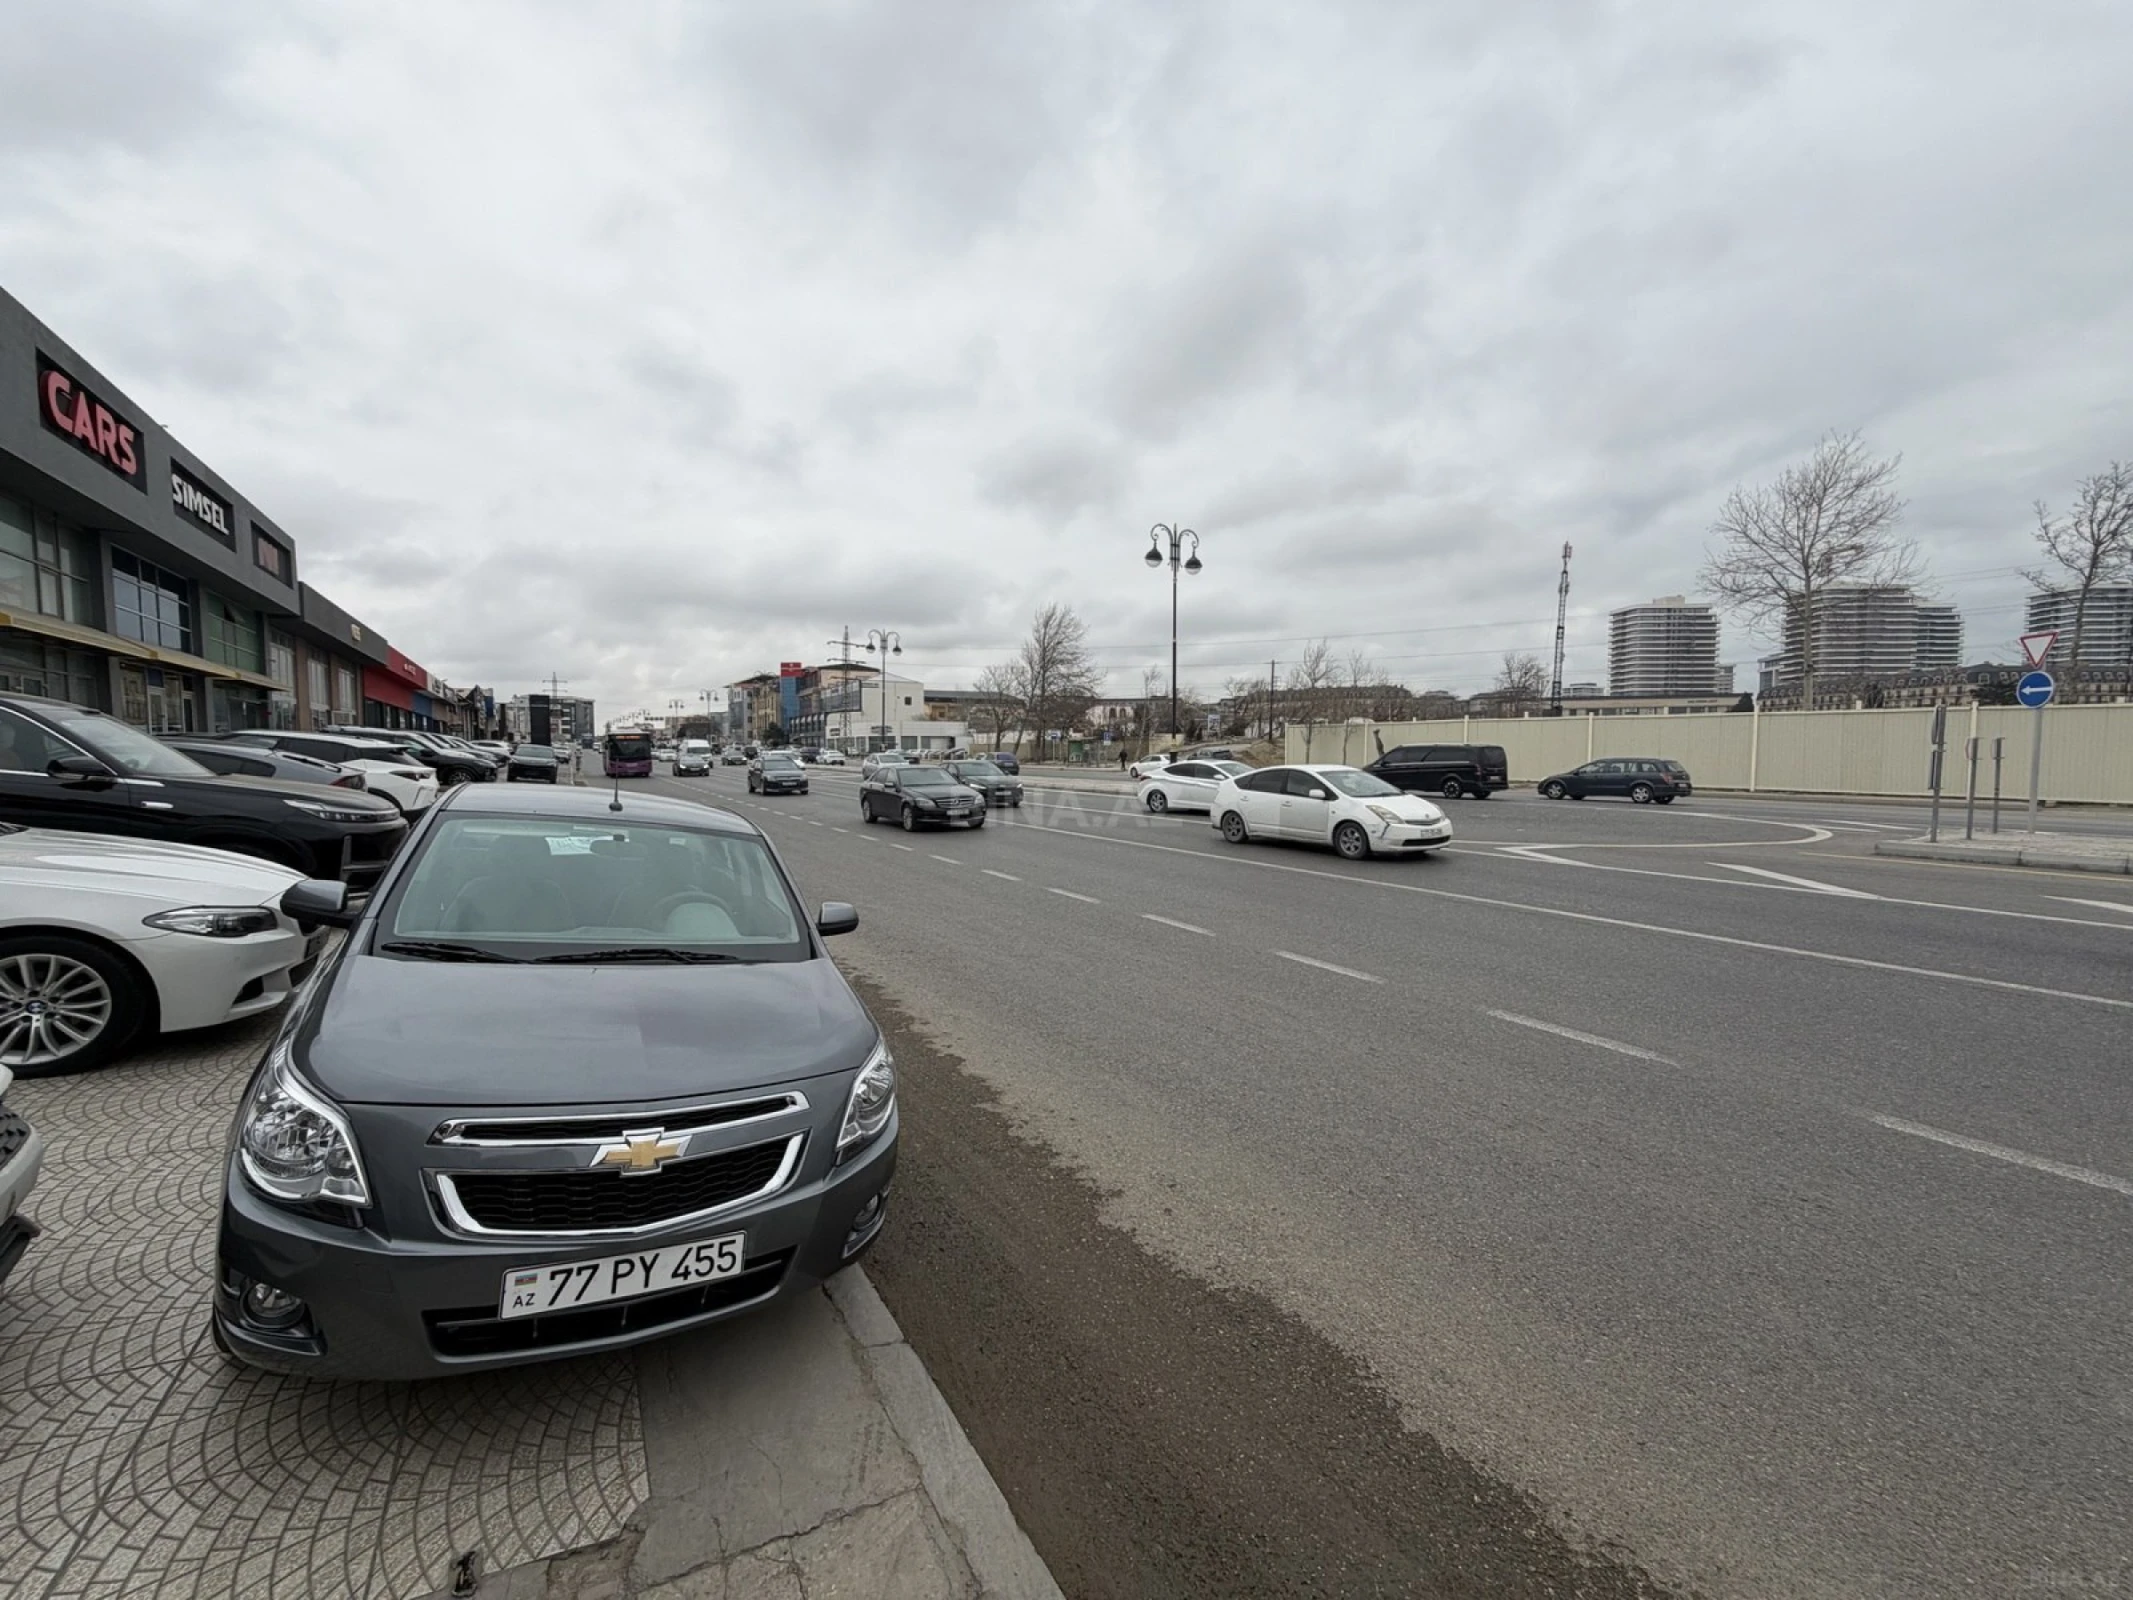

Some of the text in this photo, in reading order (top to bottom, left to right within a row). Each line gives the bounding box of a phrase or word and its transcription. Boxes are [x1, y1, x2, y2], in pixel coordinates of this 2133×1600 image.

[45, 370, 137, 475] CARS
[512, 1293, 536, 1308] AZ
[548, 1239, 737, 1306] 77 PY 455
